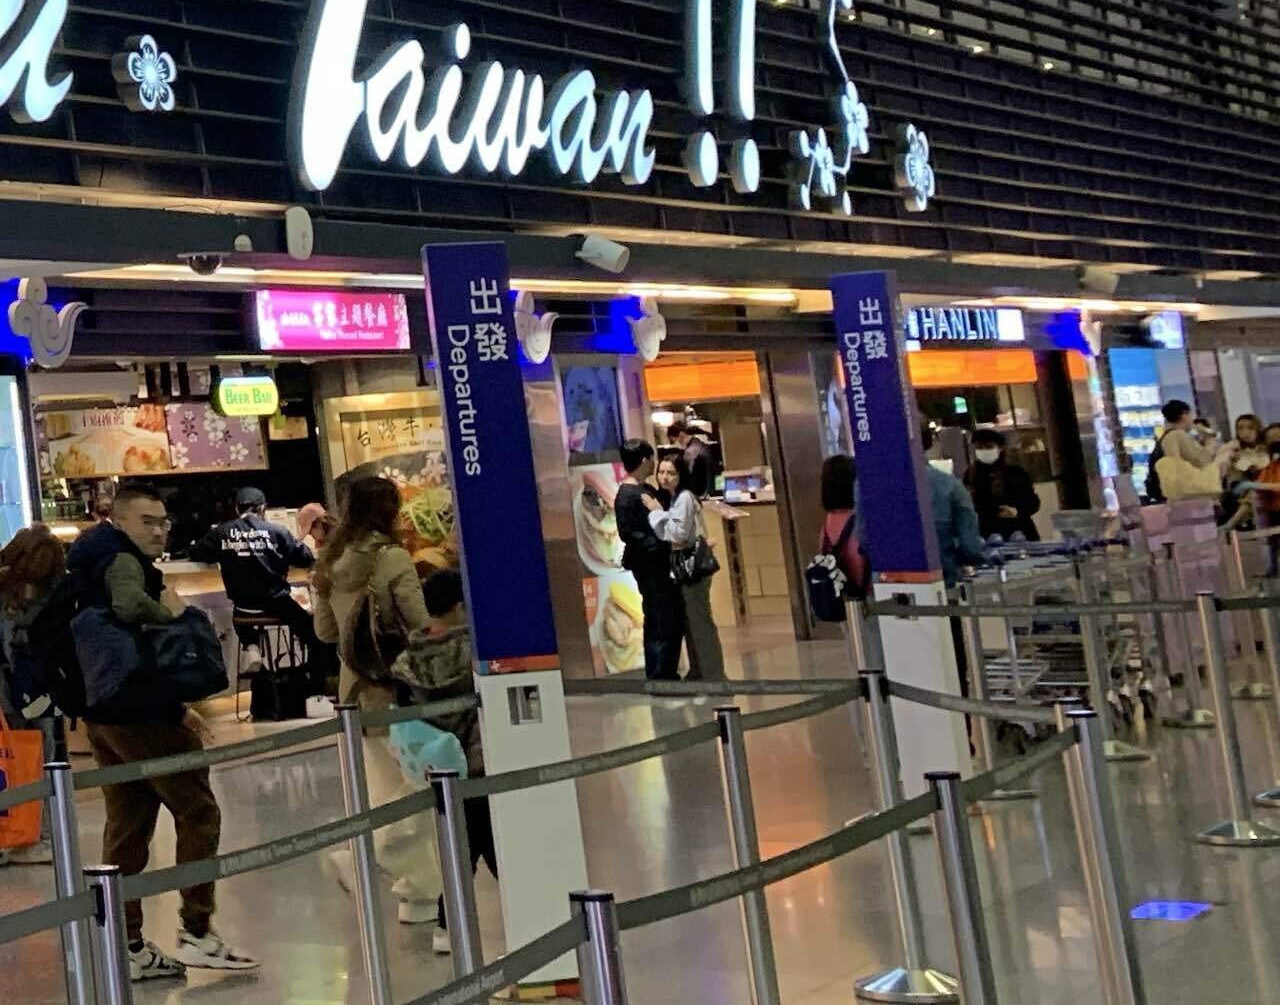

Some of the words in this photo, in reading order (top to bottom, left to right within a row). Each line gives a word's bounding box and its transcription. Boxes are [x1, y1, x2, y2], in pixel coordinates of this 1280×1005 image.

[469, 277, 509, 362] 出發
[859, 296, 889, 360] 出發
[920, 307, 999, 341] HANLIN
[447, 323, 482, 477] Departures
[844, 331, 871, 443] Departures
